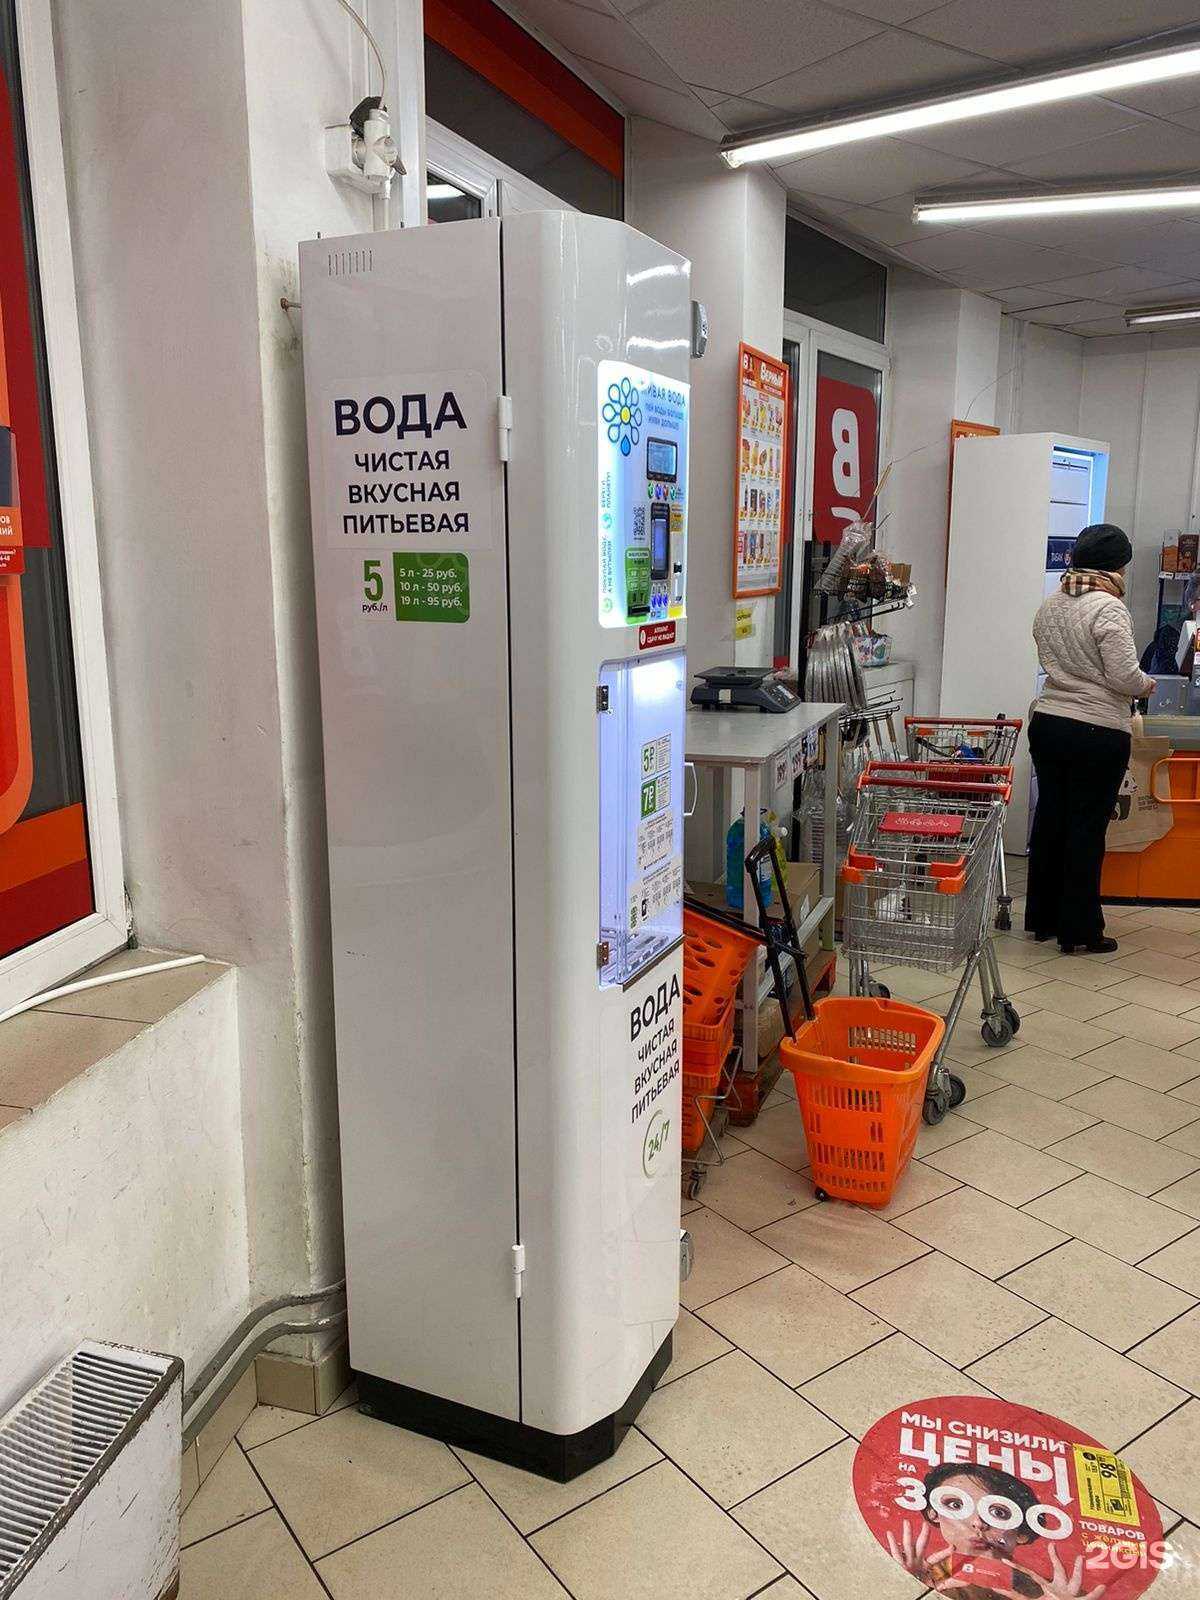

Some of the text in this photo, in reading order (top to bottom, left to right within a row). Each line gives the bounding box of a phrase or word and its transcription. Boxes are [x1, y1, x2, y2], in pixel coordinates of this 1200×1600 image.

[334, 391, 468, 440] ВОДА
[354, 450, 450, 472] ЧИСТАЯ
[348, 481, 460, 504] ВКУСНАЯ
[0, 515, 11, 525] ОВ
[343, 512, 469, 534] ПИТЬЕВАЯ
[364, 560, 384, 602] 5
[400, 568, 406, 577] 5
[422, 568, 434, 578] 25
[436, 568, 457, 580] руб.
[400, 582, 410, 591] 10
[428, 582, 440, 592] 50
[442, 582, 462, 593] руб.
[362, 603, 388, 612] руб./л
[401, 596, 410, 605] 19
[428, 596, 440, 606] 95
[442, 596, 462, 607] руб.
[630, 974, 680, 1042] ВОДА
[638, 1018, 674, 1062] ЧИСТАЯ
[634, 1038, 678, 1096] ВКУСНАЯ
[632, 1060, 680, 1124] ПИТЬЕВАЯ
[648, 1120, 670, 1162] 24/7
[901, 1412, 1066, 1454] МЫ СНИЗИЛИ
[898, 1460, 917, 1474] НА
[900, 1427, 1073, 1506] ЦЕНЫ
[894, 1476, 1074, 1540] 3000
[1079, 1520, 1146, 1541] ТОВАРОВ
